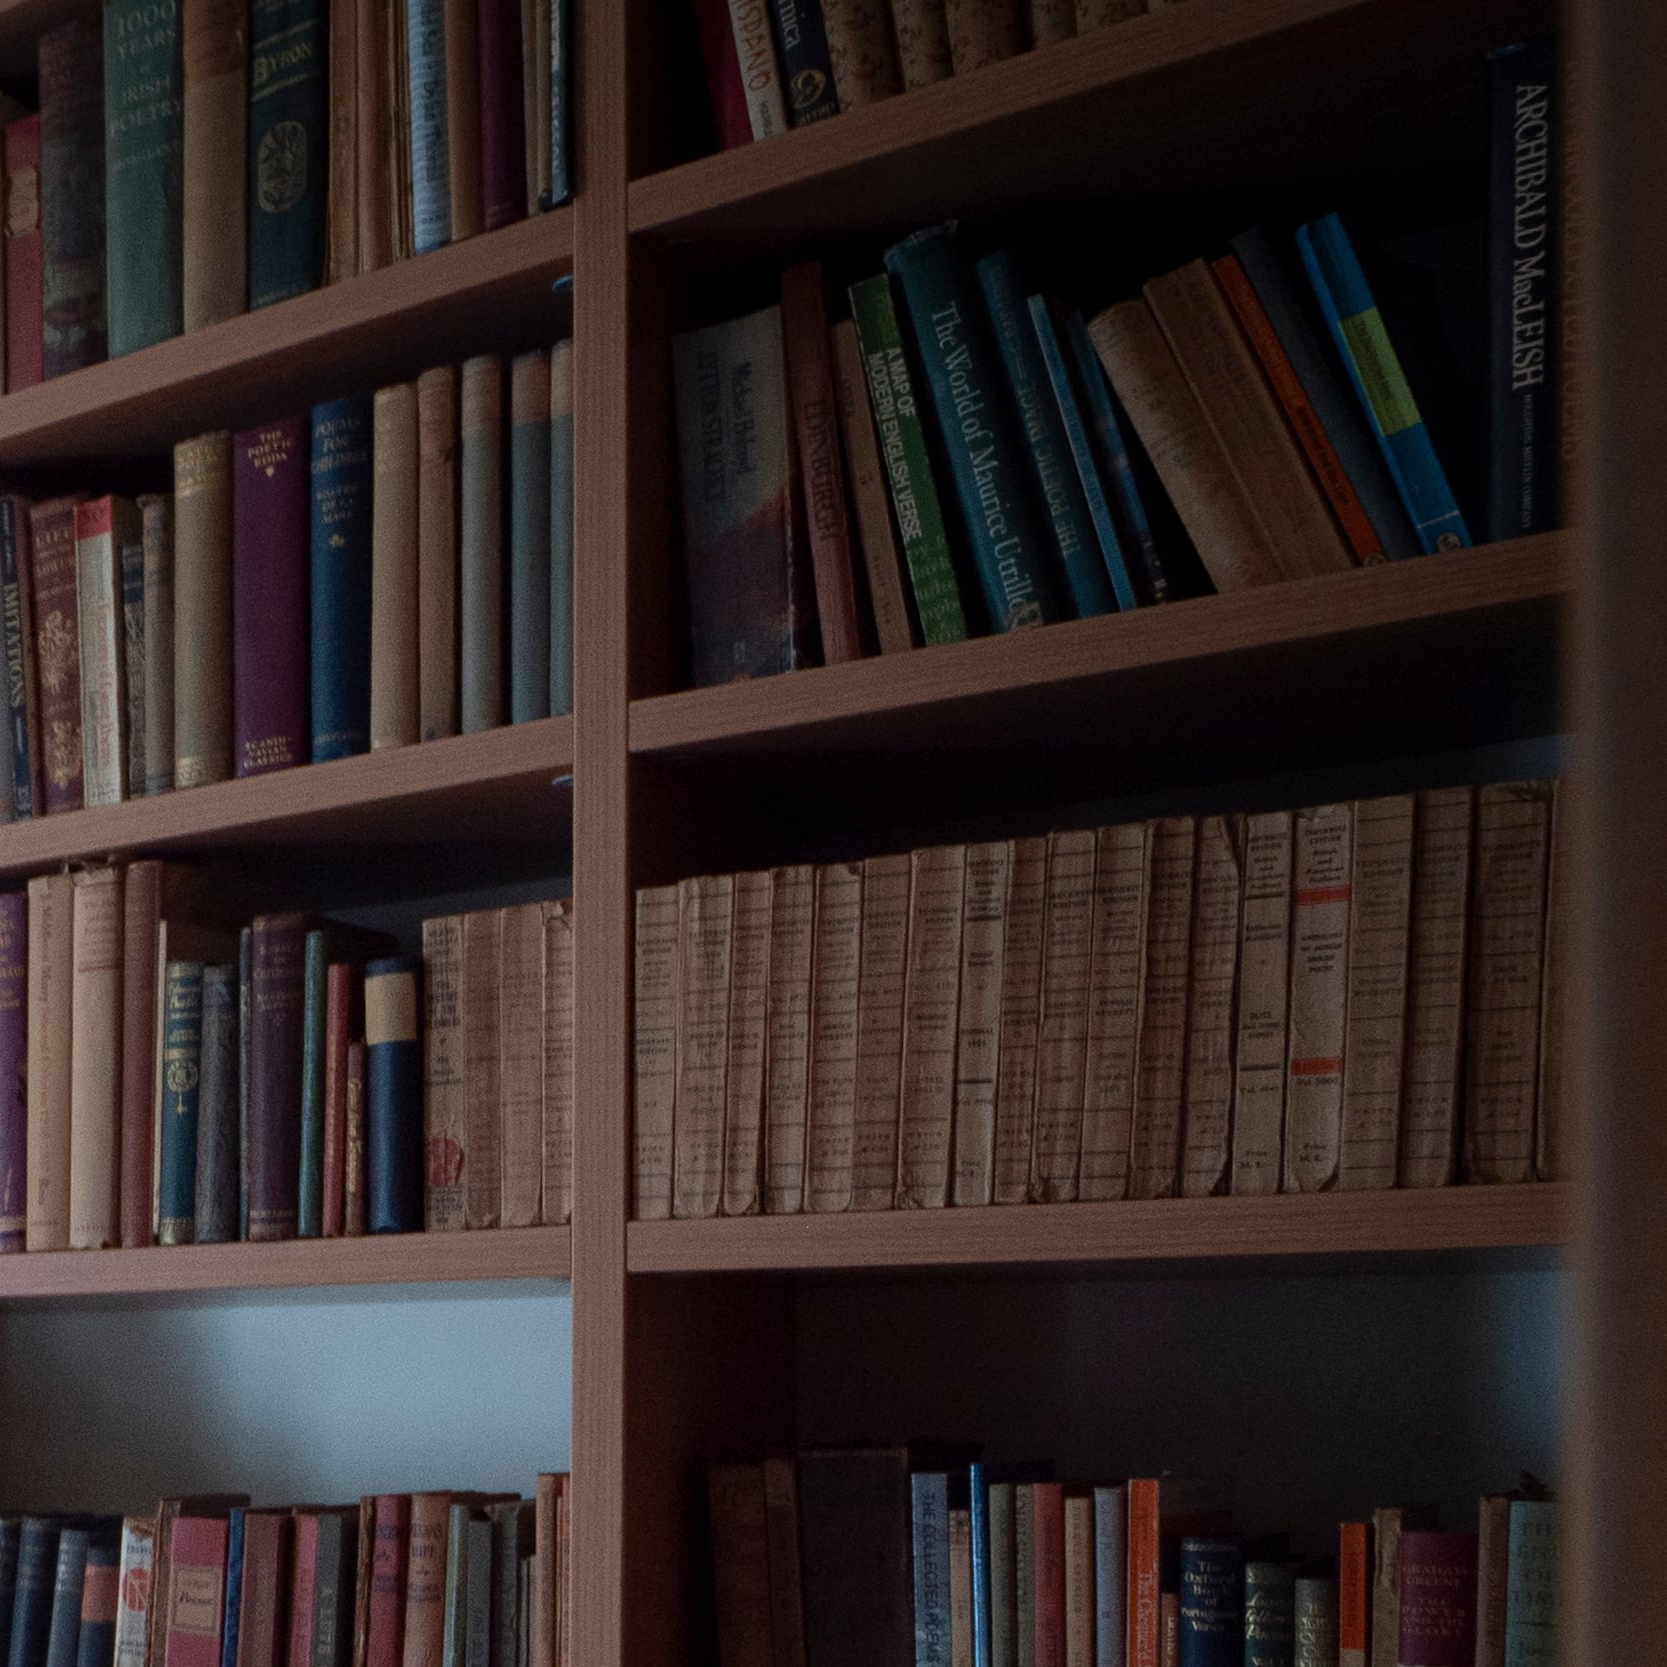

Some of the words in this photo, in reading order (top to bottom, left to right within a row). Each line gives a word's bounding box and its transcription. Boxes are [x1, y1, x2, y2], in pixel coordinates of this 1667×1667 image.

[115, 28, 178, 61] YEARS
[121, 76, 172, 107] IRISH
[1512, 83, 1549, 249] ARCHIBALD
[931, 301, 962, 349] The
[1511, 257, 1548, 392] MacLEISH
[867, 352, 894, 421] MODERN
[886, 358, 910, 388] MAP
[896, 388, 918, 419] OF
[942, 344, 985, 418] World
[247, 436, 296, 460] POETIC
[880, 421, 909, 484] ENGLISH
[960, 416, 994, 445] of
[803, 401, 843, 545] EDINBURGH
[968, 442, 1011, 539] Maurice
[1036, 443, 1069, 518] POETIC
[893, 482, 923, 546] VERSE
[2, 582, 25, 709] IMITATIONS
[1401, 1604, 1468, 1619] POWER
[1401, 1625, 1464, 1638] GLORY
